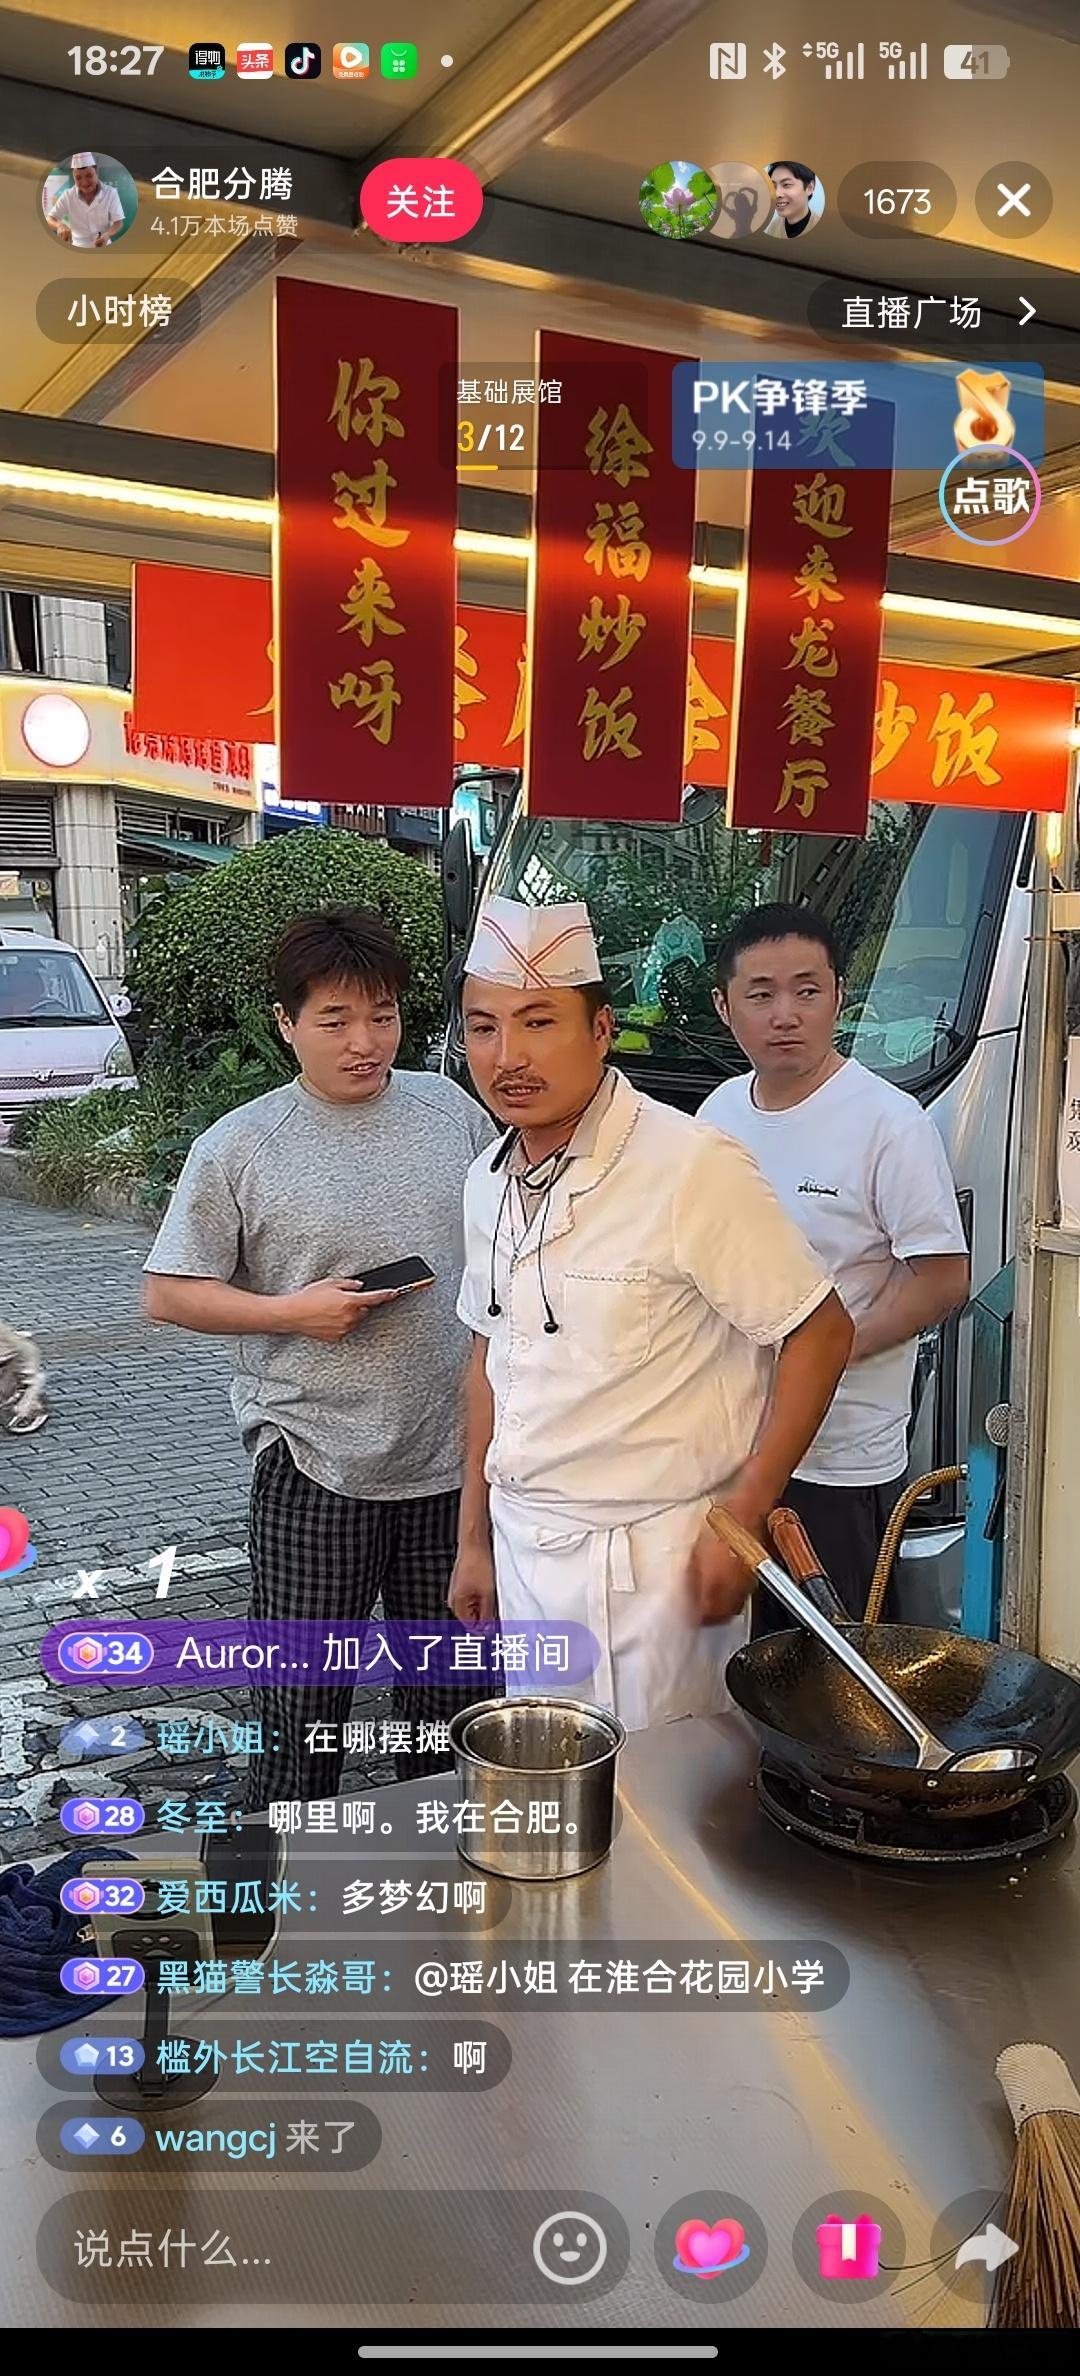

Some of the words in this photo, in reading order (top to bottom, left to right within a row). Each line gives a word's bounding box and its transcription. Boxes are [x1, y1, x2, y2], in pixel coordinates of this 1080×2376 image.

[327, 357, 410, 745] 你过来呀
[576, 403, 654, 762] 徐福炒饭
